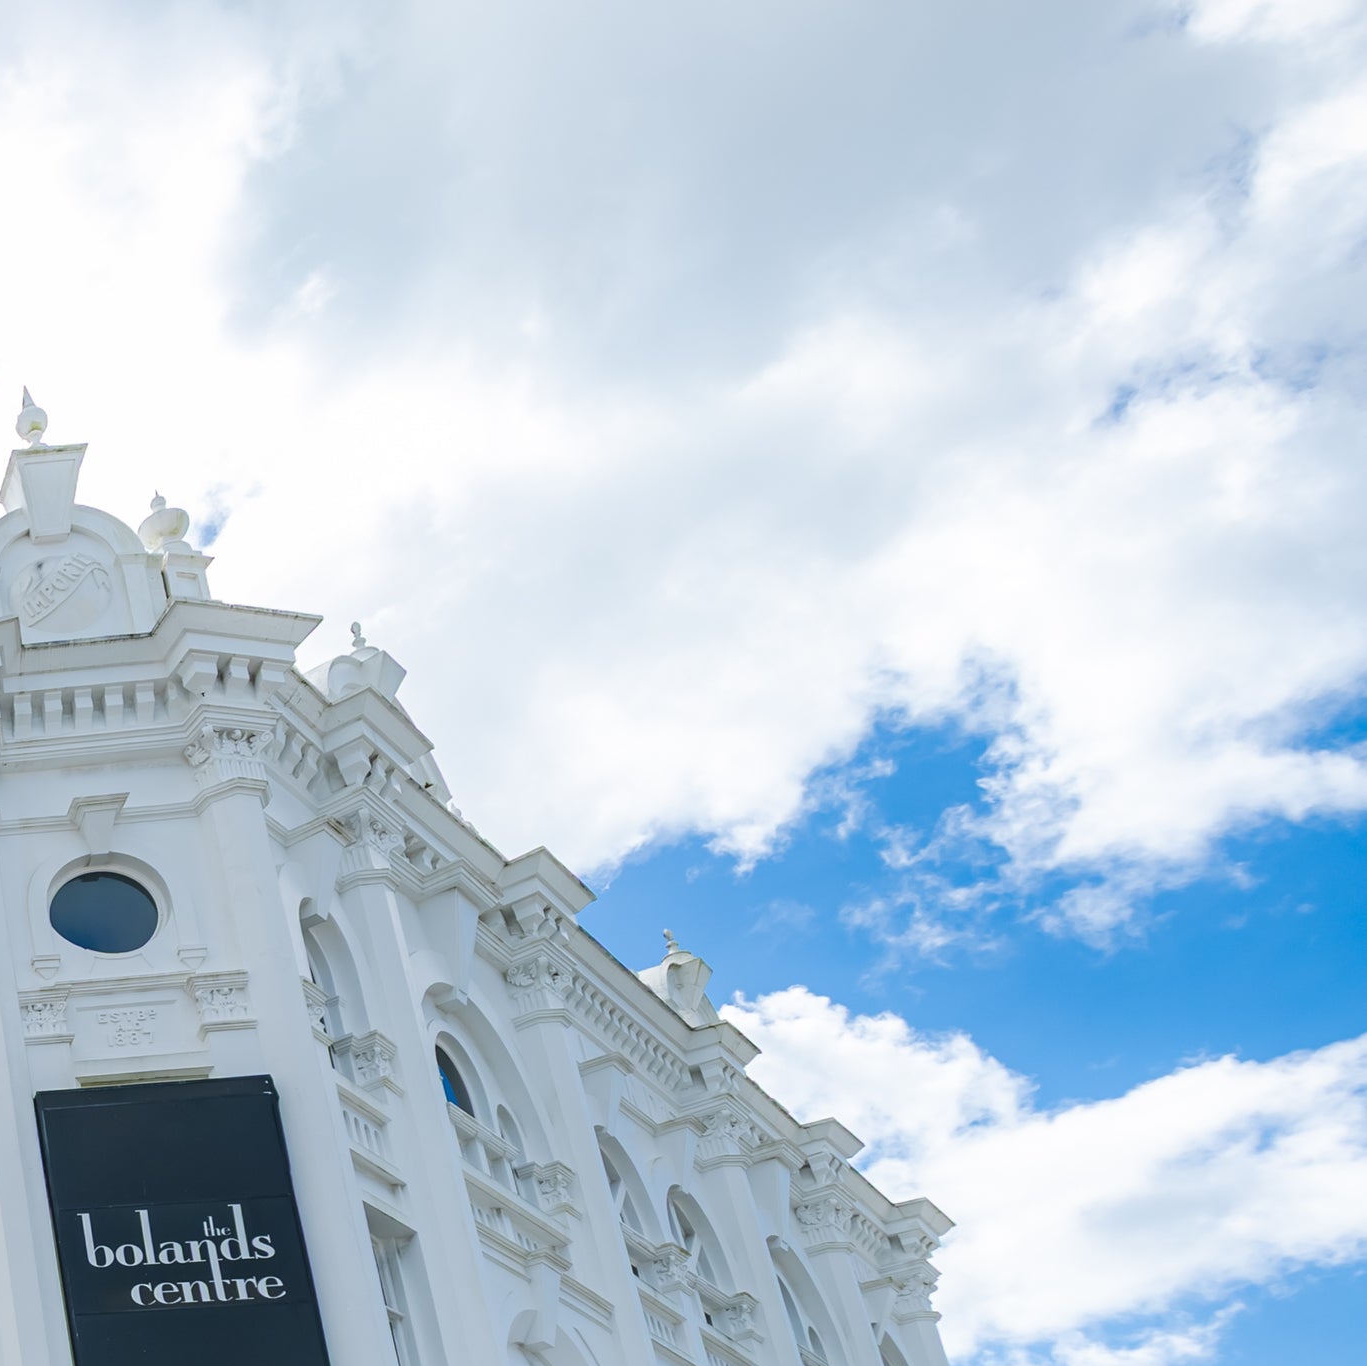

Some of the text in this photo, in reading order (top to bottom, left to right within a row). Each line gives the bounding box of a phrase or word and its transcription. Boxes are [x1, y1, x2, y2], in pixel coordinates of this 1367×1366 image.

[76, 1203, 276, 1268] bolands
[203, 1215, 231, 1237] the
[130, 1275, 286, 1306] centre
